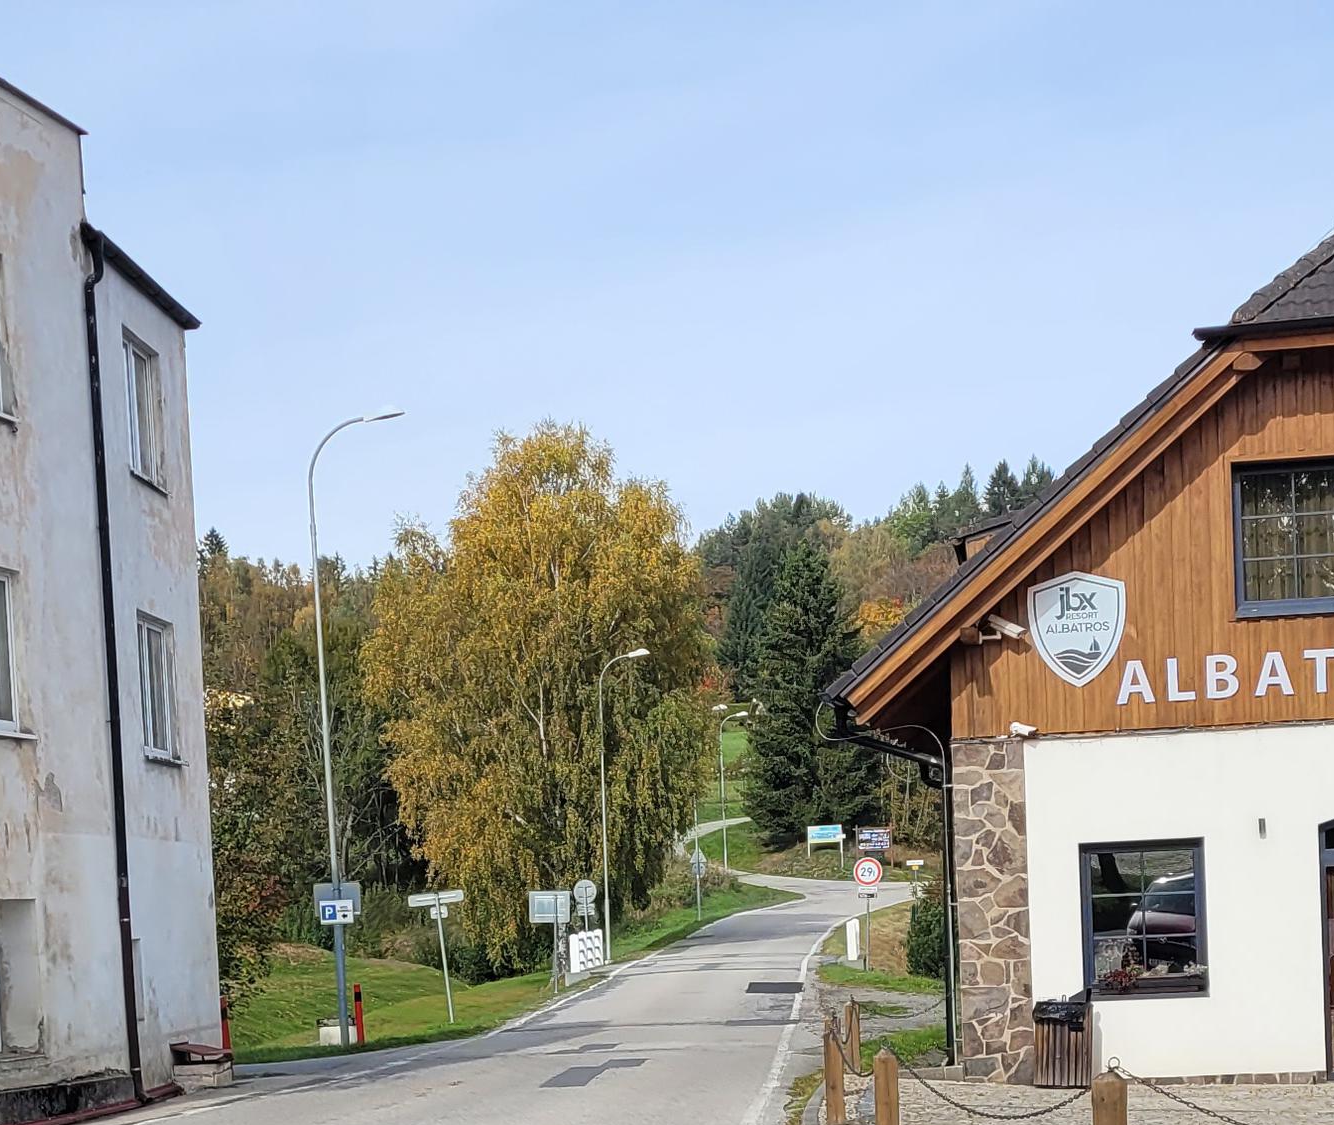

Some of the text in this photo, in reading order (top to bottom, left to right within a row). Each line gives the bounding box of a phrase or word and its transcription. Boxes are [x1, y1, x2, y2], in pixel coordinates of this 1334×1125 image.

[1055, 587, 1098, 620] jbx
[1066, 611, 1098, 620] RESORT
[1046, 621, 1110, 634] ALBATROS
